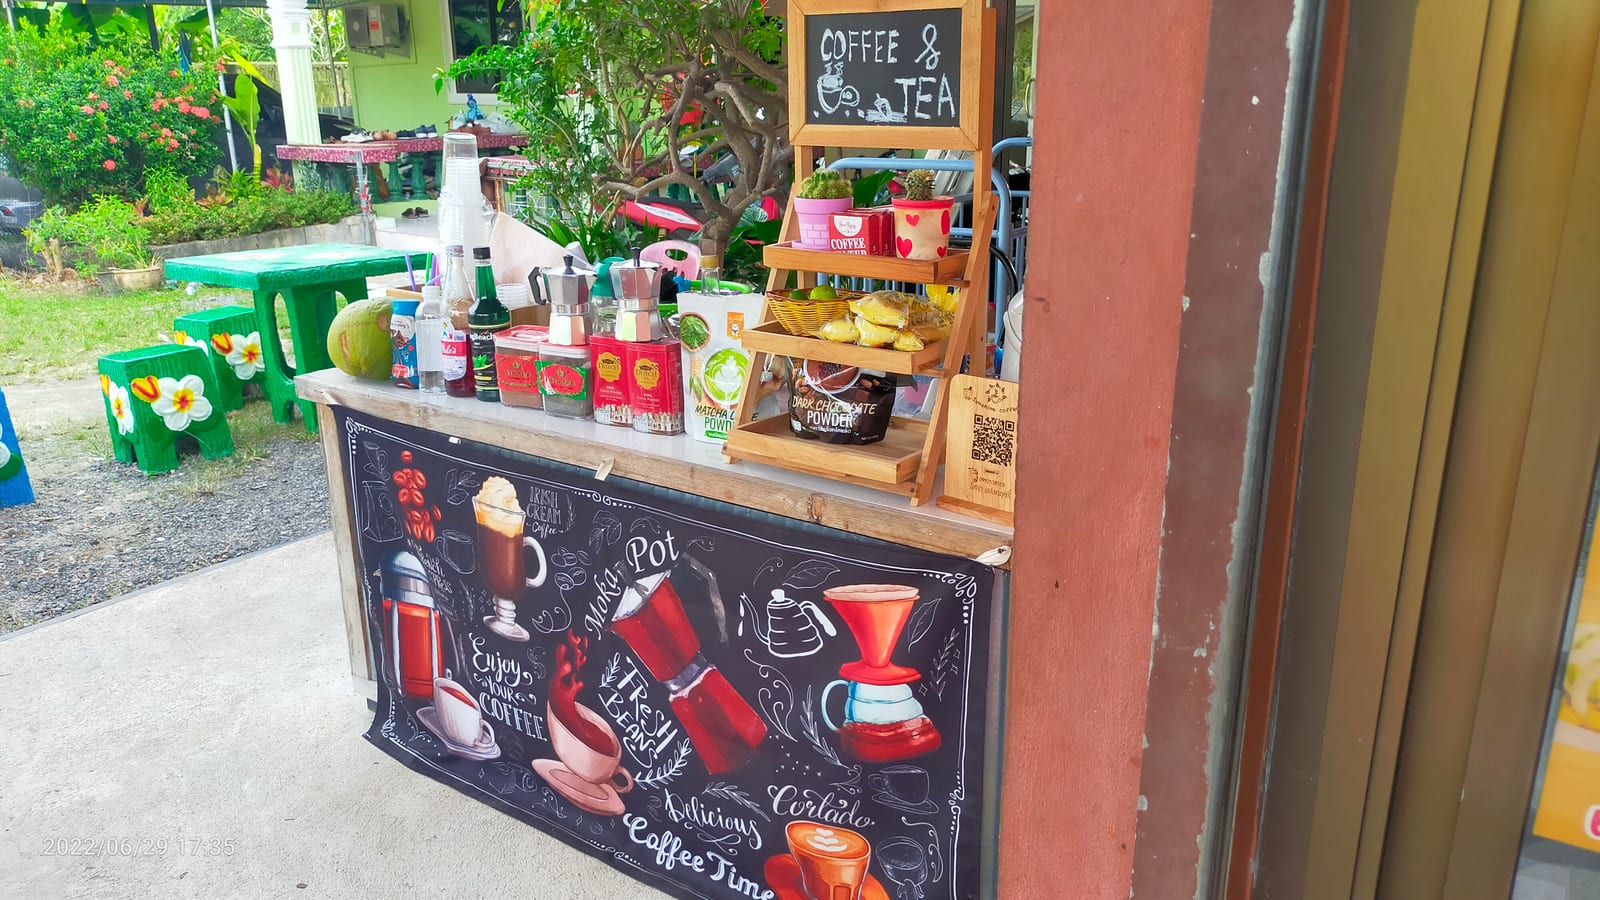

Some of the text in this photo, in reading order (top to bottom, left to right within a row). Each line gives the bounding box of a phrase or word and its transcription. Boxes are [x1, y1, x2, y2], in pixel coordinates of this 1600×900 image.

[820, 23, 941, 70] COFFEE &
[894, 73, 955, 120] TEA
[831, 237, 866, 250] COFFEE
[694, 405, 728, 420] MATCHA
[704, 416, 735, 432] POWD
[792, 396, 814, 410] DARK
[807, 410, 854, 428] POWDER
[526, 502, 562, 525] CREAM
[529, 486, 559, 509] IRISH
[584, 529, 680, 640] Moka Pot
[469, 632, 533, 687] Enjoy
[487, 675, 519, 705] YOUR
[479, 692, 548, 742] COFFEE
[598, 688, 658, 769] BEANS
[664, 788, 763, 850] Delicious
[767, 784, 871, 828] Cortado
[623, 812, 775, 900] Coffee Time
